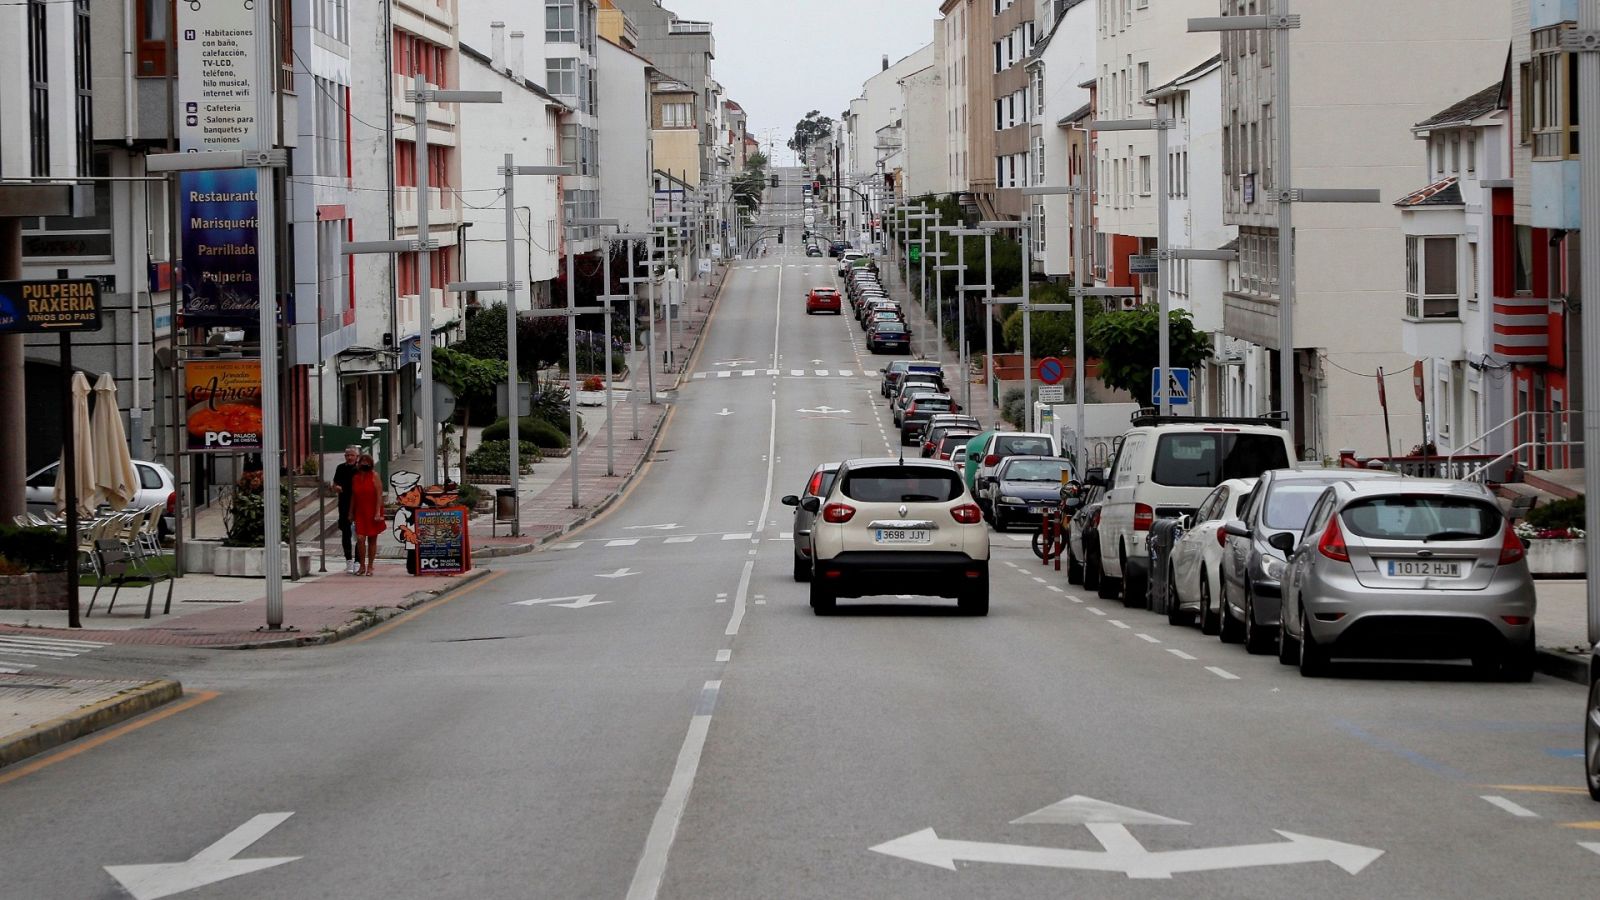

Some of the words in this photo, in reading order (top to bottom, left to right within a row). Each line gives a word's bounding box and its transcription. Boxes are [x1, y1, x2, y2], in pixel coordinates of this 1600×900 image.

[219, 79, 250, 87] musical,
[203, 89, 233, 97] internet
[203, 126, 242, 134] banquetes
[198, 244, 256, 256] Parrillada
[202, 270, 253, 285] Pulpería
[22, 282, 95, 299] PULPERIA
[28, 296, 96, 313] RAXERIA
[26, 312, 56, 322] VIÑOS
[58, 313, 73, 321] DO
[74, 312, 96, 321] PAIS
[192, 376, 257, 412] Arroz
[205, 431, 232, 446] PC
[883, 530, 905, 540] 3698
[909, 530, 925, 540] JJY
[420, 558, 439, 569] PC
[1398, 562, 1430, 575] 1012
[1433, 563, 1458, 575] HJW
